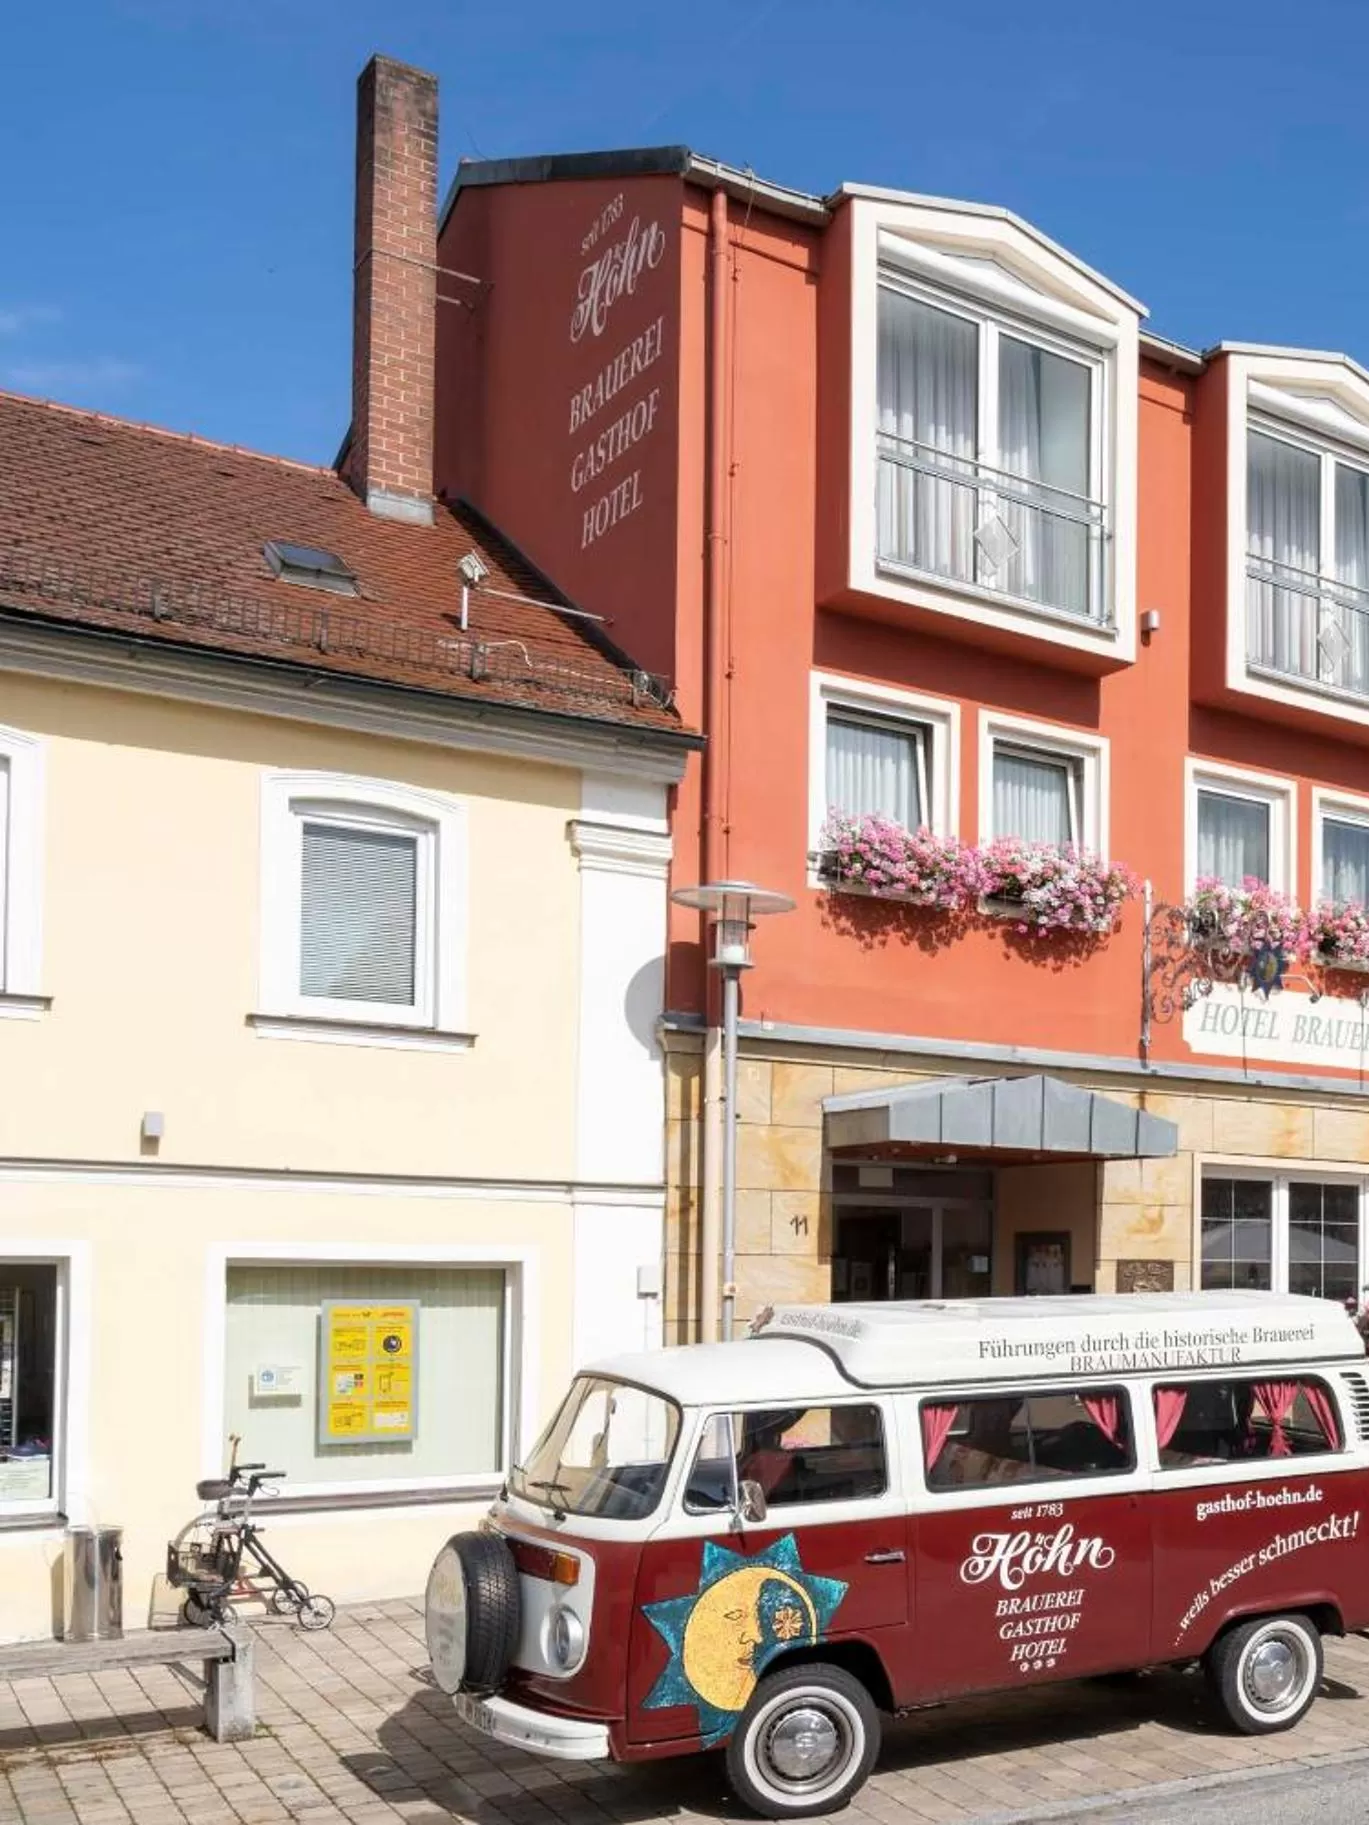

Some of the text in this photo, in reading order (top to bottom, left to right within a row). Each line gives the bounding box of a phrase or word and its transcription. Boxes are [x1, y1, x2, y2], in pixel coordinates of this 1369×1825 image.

[570, 216, 666, 344] Höhn
[569, 316, 665, 435] BRAUEREI
[571, 388, 661, 493] GASTHOF
[581, 469, 643, 550] HOTEL
[1201, 1001, 1280, 1040] HOTEL
[790, 1214, 809, 1237] 11
[978, 1323, 1316, 1360] Führungen durch die historische Brauerei
[1070, 1346, 1242, 1373] BRAUMANUFAKTUR
[1011, 1502, 1064, 1519] seit 1783
[1196, 1485, 1324, 1520] gasthof-hoehn.de
[960, 1524, 1115, 1590] Höhn
[1208, 1550, 1257, 1595] besser
[1258, 1511, 1359, 1566] schmeckt!
[995, 1589, 1085, 1617] BRAUEREI
[999, 1612, 1082, 1640] GASTHOF
[1010, 1637, 1068, 1662] HOTEL
